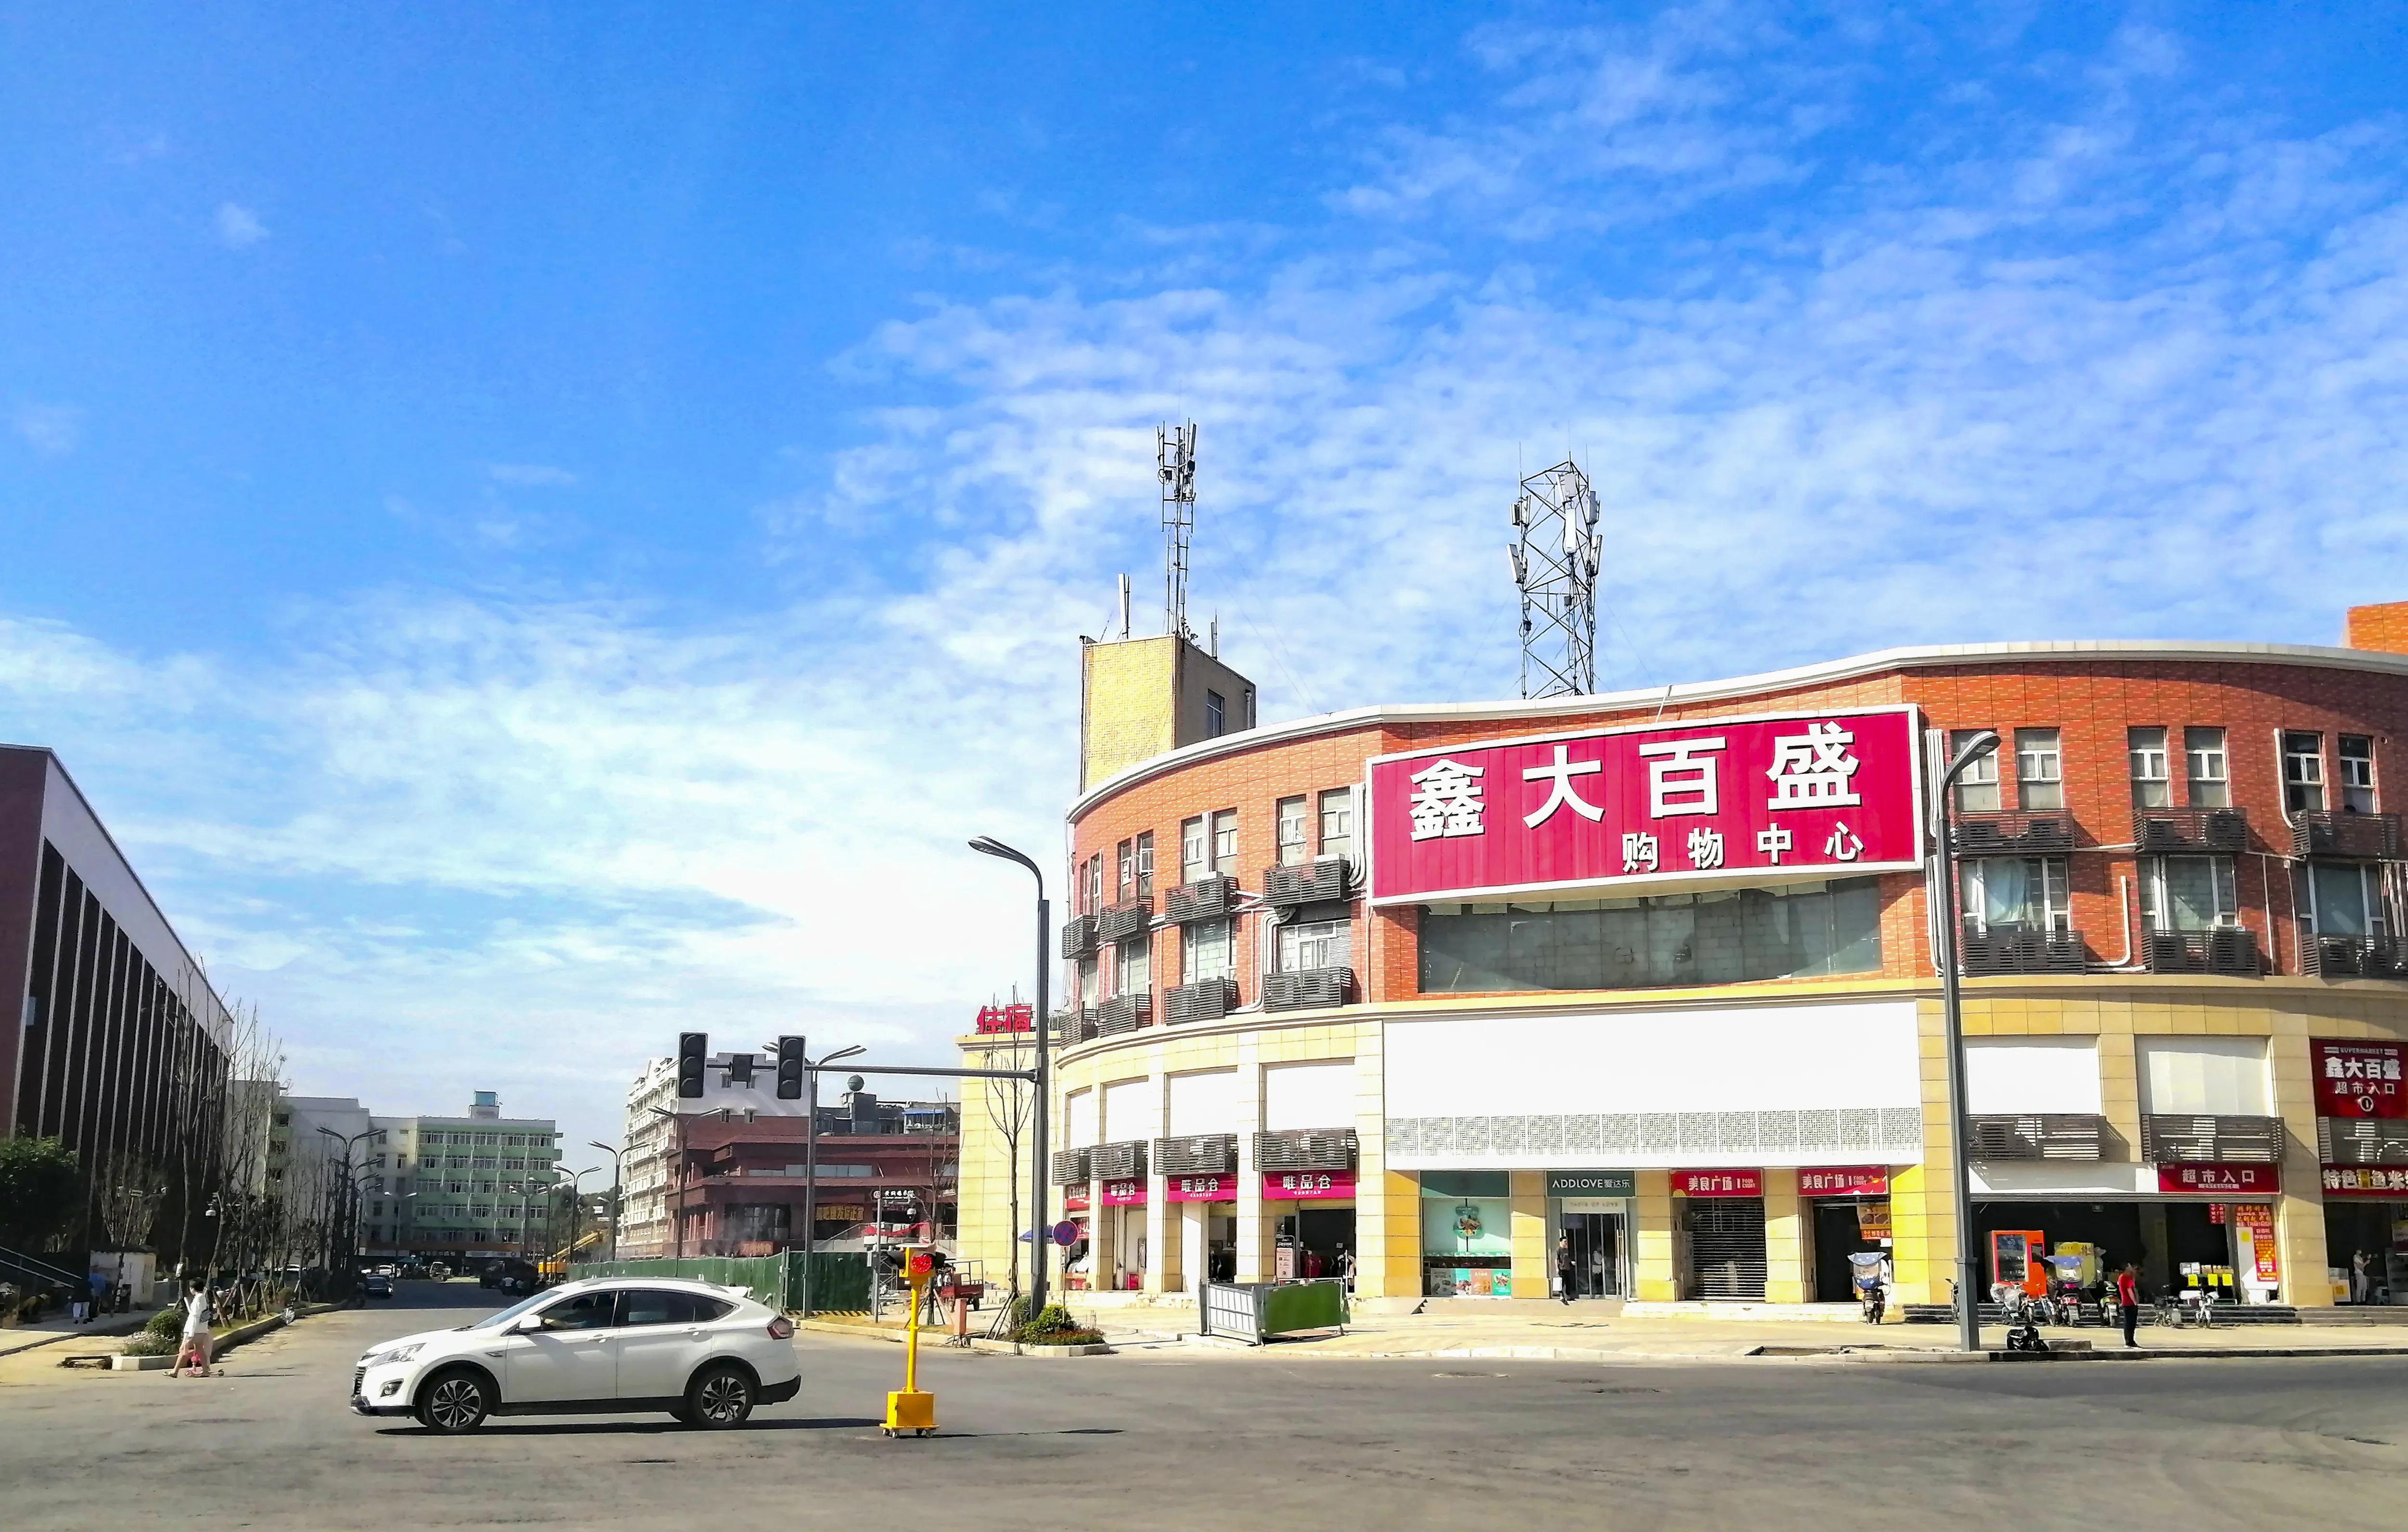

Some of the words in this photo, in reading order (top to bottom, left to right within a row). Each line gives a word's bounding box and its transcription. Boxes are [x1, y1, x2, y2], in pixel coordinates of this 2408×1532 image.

[1409, 721, 1862, 841] 鑫大百盛
[1622, 821, 1865, 872] 购物中心
[977, 1004, 1031, 1034] 住宿
[2324, 1057, 2401, 1080] 鑫大百盛
[1688, 1175, 1732, 1191] 美食广场
[1802, 1173, 1844, 1189] 美食广场
[2182, 1168, 2254, 1183] 超市入口
